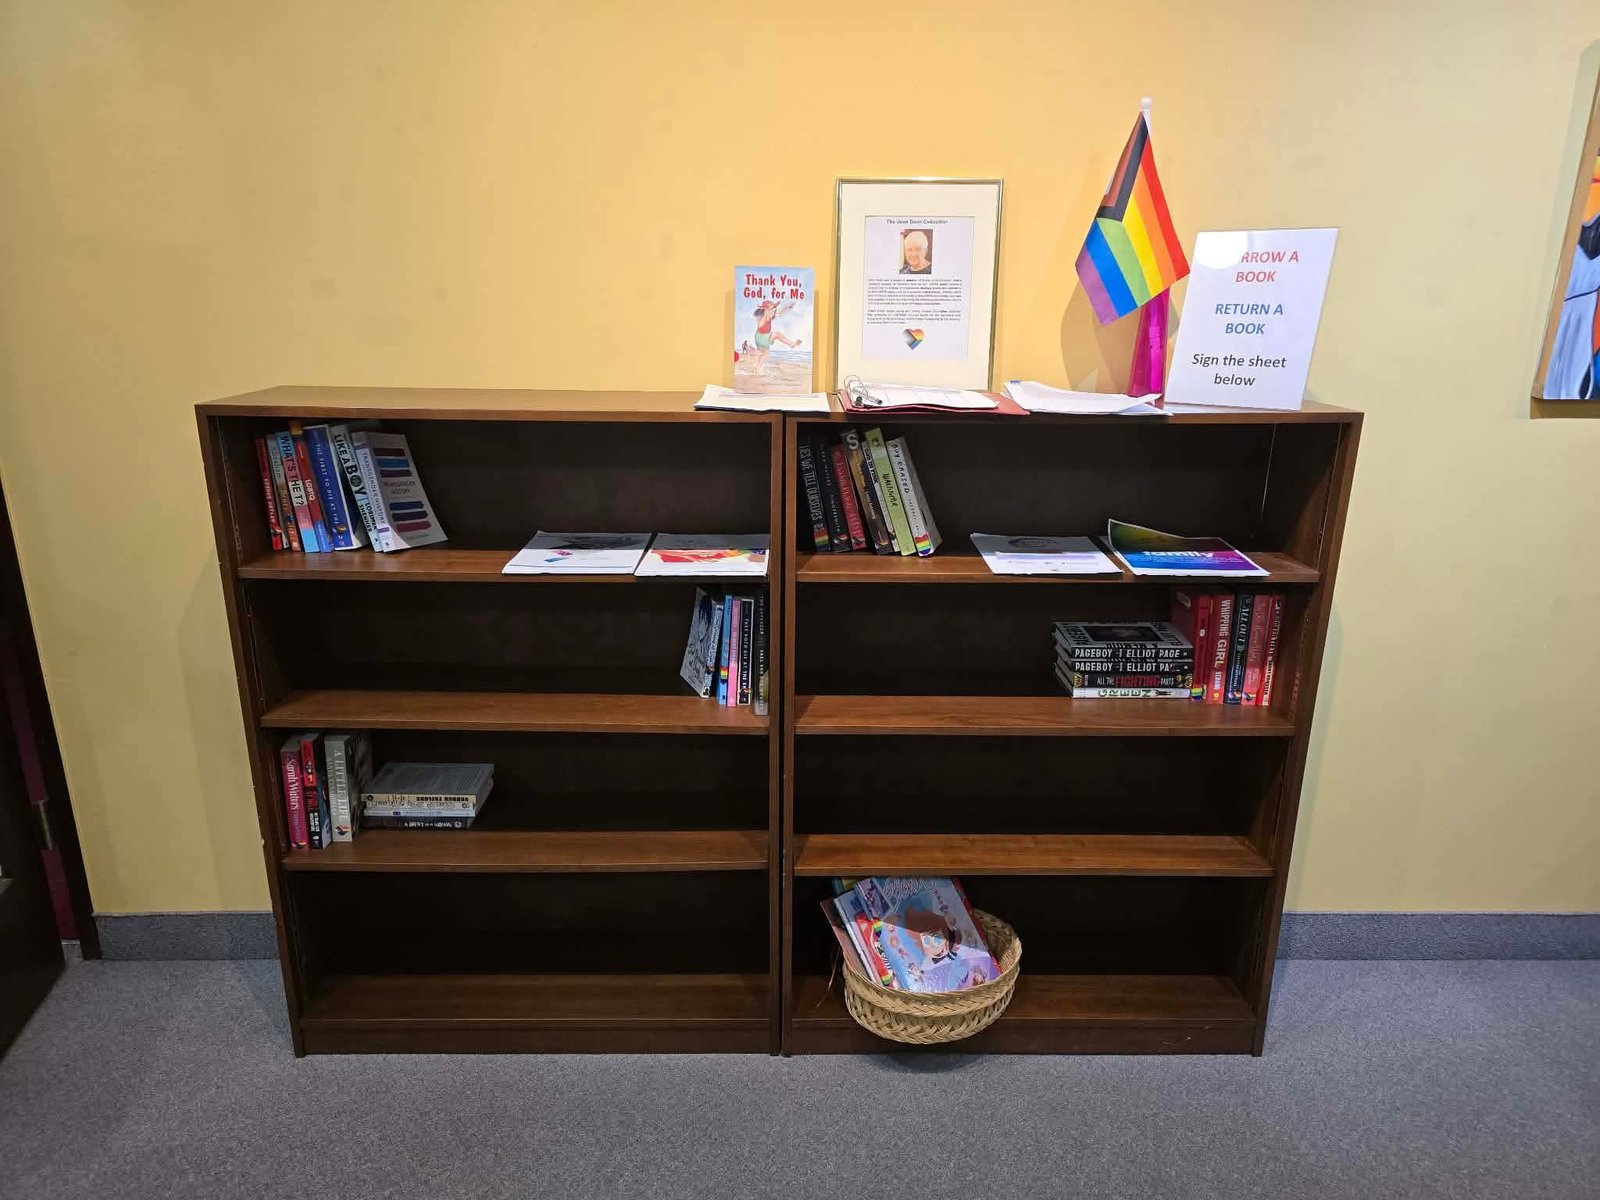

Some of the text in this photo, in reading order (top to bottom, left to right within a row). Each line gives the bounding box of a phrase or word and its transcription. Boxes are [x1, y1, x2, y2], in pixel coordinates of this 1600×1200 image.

[1241, 250, 1300, 263] RROW A
[745, 274, 802, 288] Thank You,
[1235, 270, 1277, 283] BOOK
[743, 287, 805, 300] God, for Me
[1215, 303, 1284, 315] RETURN A
[1225, 323, 1266, 335] BOOK
[1192, 353, 1287, 368] Sign the sheet
[1214, 373, 1256, 386] below
[280, 435, 296, 471] WHAT'S
[319, 458, 328, 476] FIRST
[334, 434, 347, 457] LIKE
[341, 458, 350, 467] A
[346, 464, 367, 495] BOY
[892, 444, 909, 494] BOY ERASED
[289, 474, 300, 494] THE
[803, 470, 817, 487] TELL
[294, 494, 305, 505] T?
[807, 485, 823, 520] OURSELVES
[373, 497, 386, 524] HISTORY
[1218, 599, 1231, 637] WHIPPING
[1074, 648, 1180, 658] PAGEBOY ELLIOT PAGE
[1214, 639, 1227, 668] GIRL
[1075, 662, 1113, 671] PAGEBOY
[1127, 662, 1157, 672] ELLIOT
[1096, 676, 1106, 685] ALL
[287, 758, 298, 783] Sarah
[335, 760, 346, 797] LITTLE
[290, 783, 300, 810] Waters
[338, 799, 348, 822] LIFE
